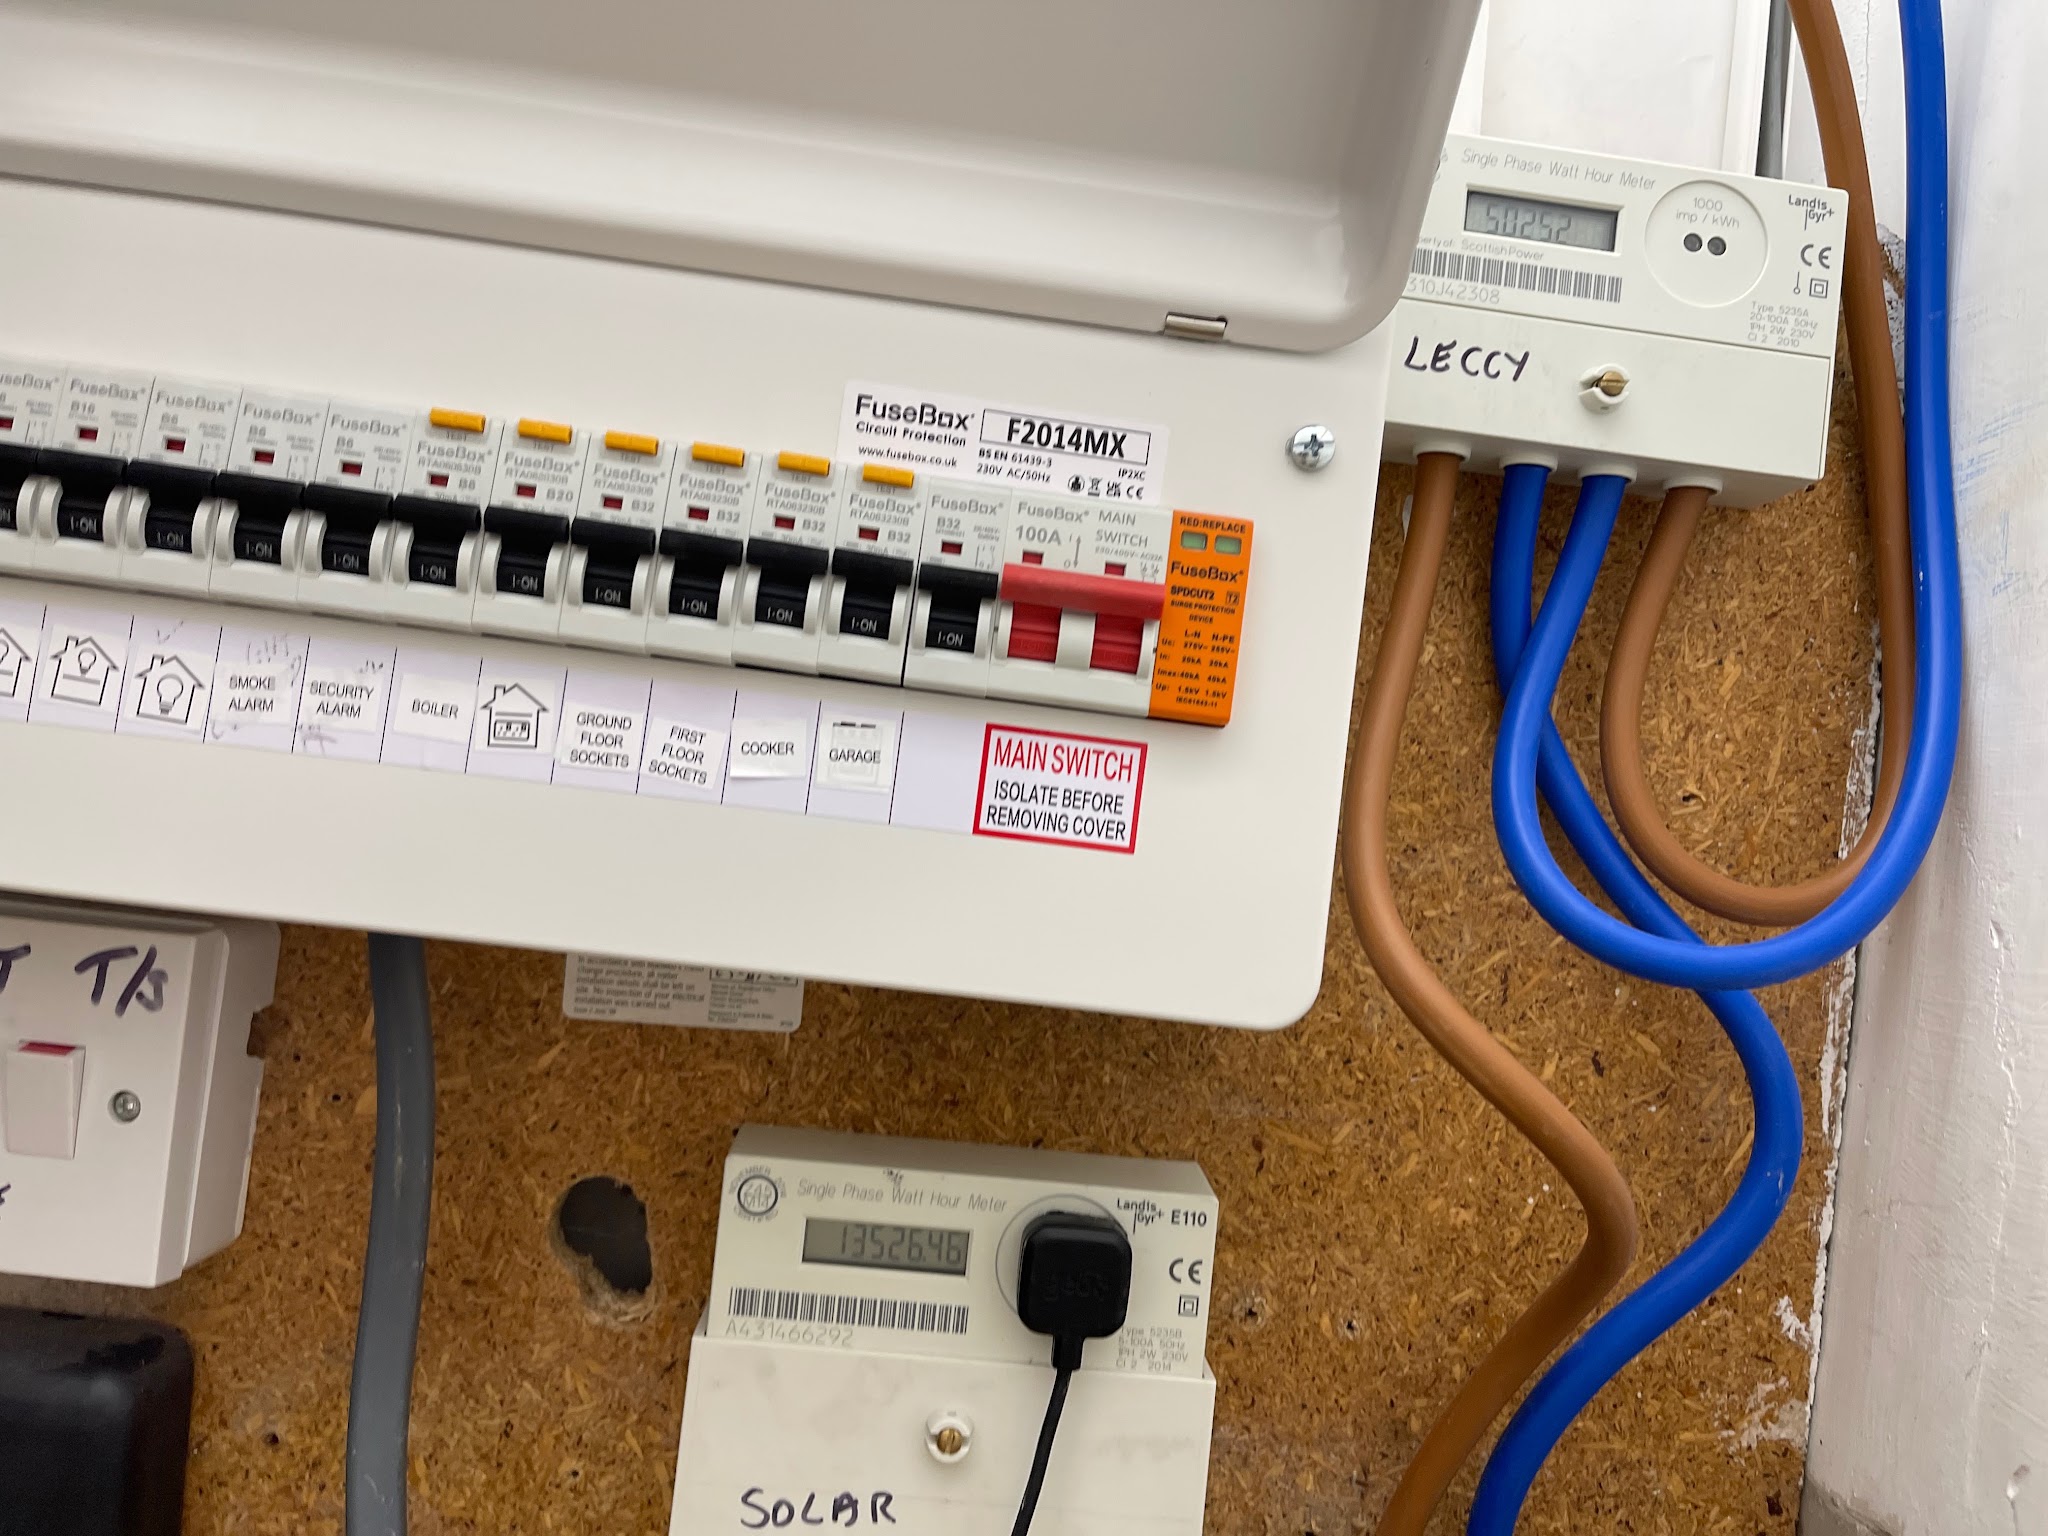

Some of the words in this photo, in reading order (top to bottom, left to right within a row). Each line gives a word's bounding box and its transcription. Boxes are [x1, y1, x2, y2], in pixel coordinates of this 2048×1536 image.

[1461, 148, 1498, 169] Single
[1503, 154, 1542, 174] Phase
[1549, 161, 1579, 180] Watt
[1584, 164, 1614, 184] Hour
[1619, 171, 1657, 191] Meter
[1694, 197, 1723, 212] 1000
[1788, 194, 1828, 210] Landis
[1486, 202, 1572, 244] 50252
[1675, 209, 1698, 224] imp
[1701, 213, 1708, 223] /
[1711, 213, 1740, 229] kWh
[1752, 300, 1774, 313] Type
[1769, 324, 1786, 335] 2W
[1790, 327, 1815, 339] 230V
[1794, 317, 1818, 330] 50Hz
[1777, 336, 1800, 348] 2010
[1403, 335, 1530, 382] LECCY
[243, 402, 313, 426] FuseBox
[855, 393, 970, 431] FuseBox
[331, 413, 400, 437] FuseBox
[856, 420, 897, 438] Circuit
[902, 426, 967, 448] Protection
[1006, 416, 1128, 459] F2014MX
[504, 451, 573, 474] FuseBox
[858, 445, 958, 468] www.fusebox.co.uk
[978, 447, 991, 459] BS
[994, 449, 1008, 462] EN
[1011, 452, 1053, 468] 61439-3
[593, 463, 658, 485] FuseBox
[976, 462, 1002, 477] 230V
[1006, 467, 1051, 484] AC/50Hz
[1117, 467, 1146, 480] IP2XC
[546, 487, 574, 502] B20
[679, 473, 743, 496] FuseBox
[765, 483, 829, 505] FuseBox
[631, 500, 655, 513] B32
[849, 493, 915, 516] FuseBox
[931, 494, 997, 516] FuseBox
[1017, 501, 1083, 524] FuseBox
[716, 509, 741, 524] B32
[802, 518, 826, 533] B32
[937, 516, 961, 529] B32
[1098, 509, 1137, 526] MAIN
[887, 529, 911, 544] B32
[1015, 524, 1062, 546] 100A
[1095, 529, 1149, 548] SWITCH
[1170, 560, 1238, 583] FuseBox
[1170, 585, 1215, 600] SPDCUT2
[1170, 600, 1193, 609] SURGE
[1193, 601, 1236, 614] PROTECTION
[1188, 613, 1214, 624] DEVICE
[229, 674, 276, 691] SMOKE
[309, 679, 375, 701] SECURITY
[228, 697, 274, 713] ALARM
[316, 701, 362, 719] ALARM
[412, 698, 459, 719] BOILER
[576, 711, 633, 731] GROUND
[580, 731, 624, 749] FLOOR
[669, 724, 707, 746] FIRST
[569, 749, 630, 768] SOCKETS
[661, 742, 705, 765] FLOOR
[740, 741, 795, 757] COOKER
[828, 748, 881, 764] GARAGE
[993, 737, 1048, 772] MAIN
[1051, 744, 1134, 783] SWITCH
[648, 759, 708, 786] SOCKETS
[994, 780, 1059, 807] ISOLATE
[1062, 788, 1125, 815] BEFORE
[986, 805, 1069, 834] REMOVING
[1072, 815, 1127, 842] COVER
[798, 1178, 837, 1199] Single
[842, 1182, 884, 1203] Phase
[892, 1185, 923, 1205] Watt
[930, 1189, 961, 1209] Hour
[968, 1192, 1007, 1213] Meter
[1117, 1198, 1157, 1212] Landis
[1170, 1209, 1207, 1228] E110
[725, 1319, 854, 1347] A431466292
[1139, 1348, 1157, 1359] 2W
[1162, 1350, 1188, 1362] 230V
[740, 1487, 896, 1529] SOLAR
